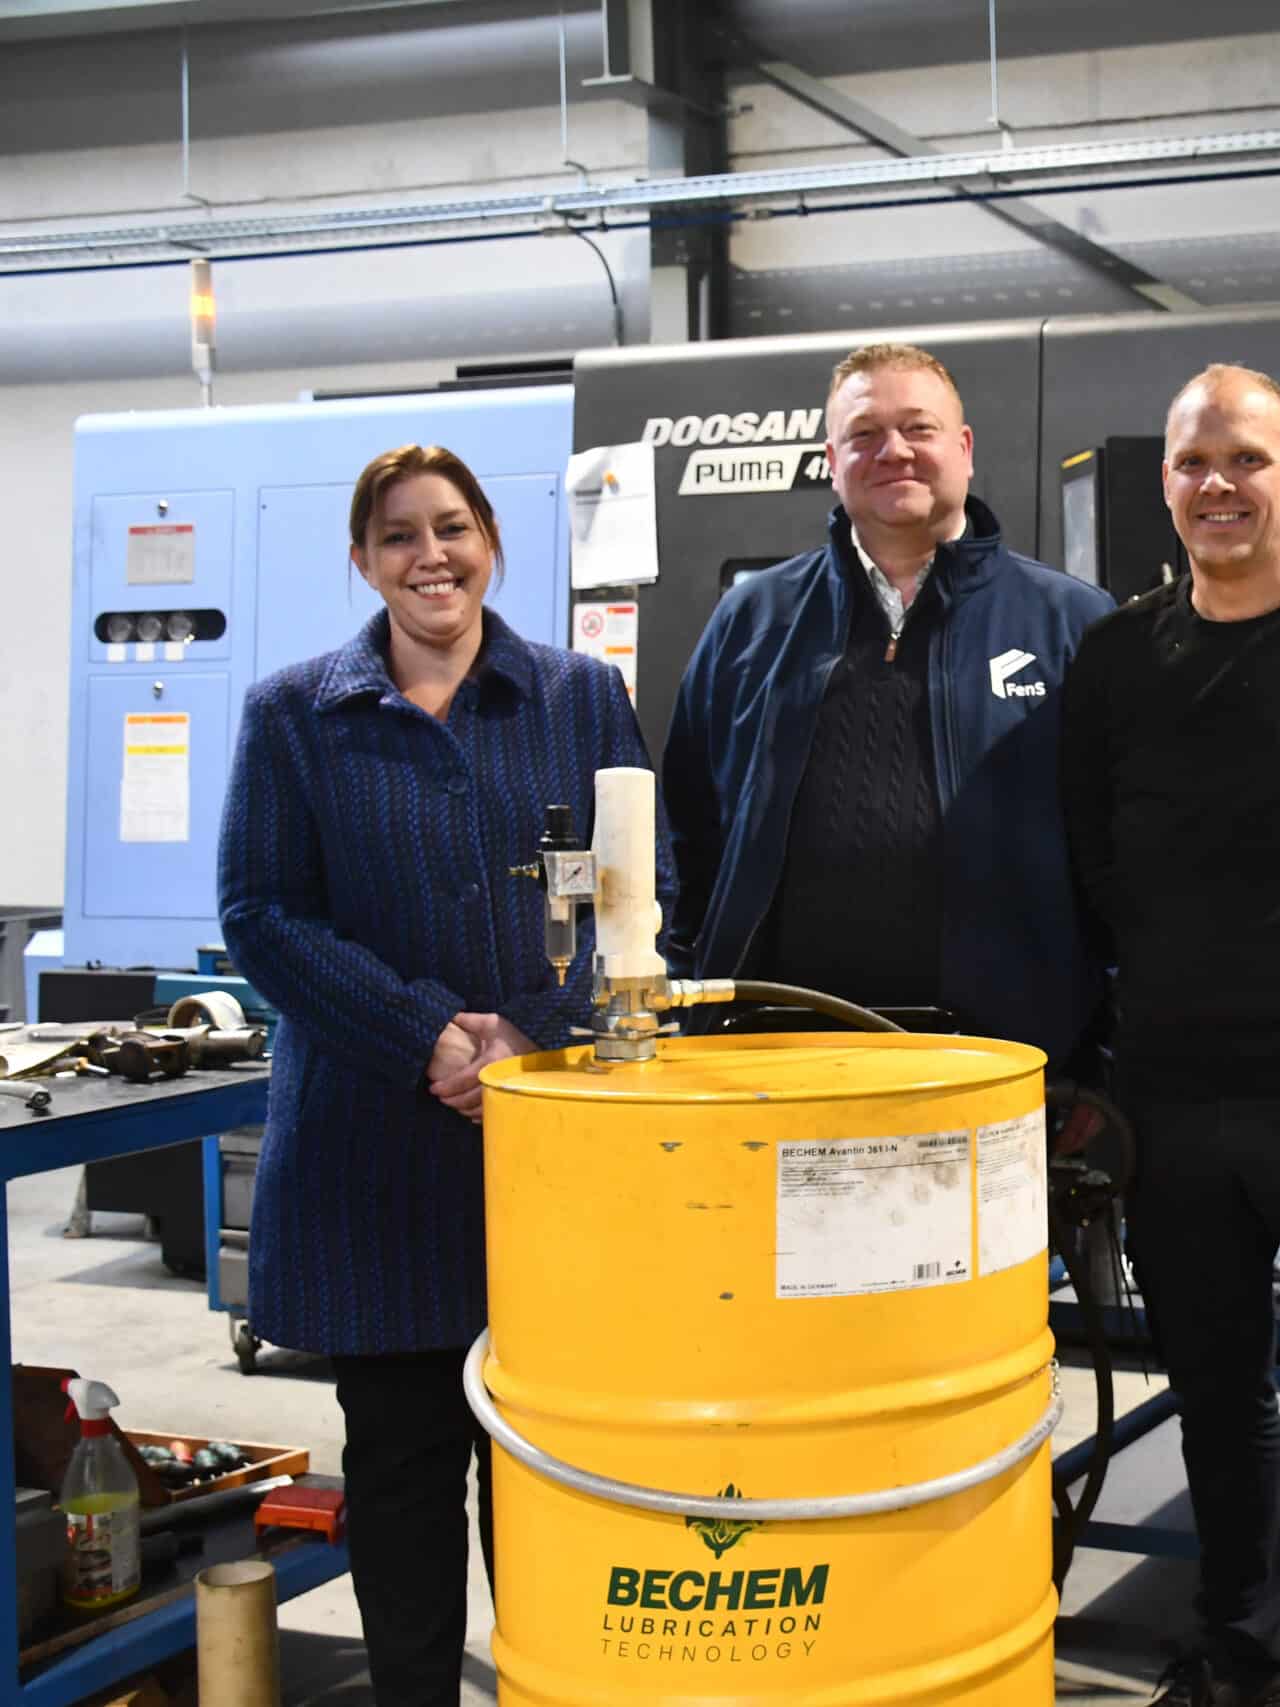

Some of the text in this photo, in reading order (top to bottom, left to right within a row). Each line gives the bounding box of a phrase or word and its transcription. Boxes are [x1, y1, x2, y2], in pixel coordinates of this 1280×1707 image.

[641, 408, 823, 447] DOOSAN
[696, 460, 784, 484] PUMA
[1006, 681, 1046, 697] FenS
[782, 1147, 827, 1158] BECHEM
[607, 1564, 830, 1611] BECHEM
[603, 1613, 822, 1637] LUBRICATION
[600, 1639, 817, 1663] TECHNOLOGY
